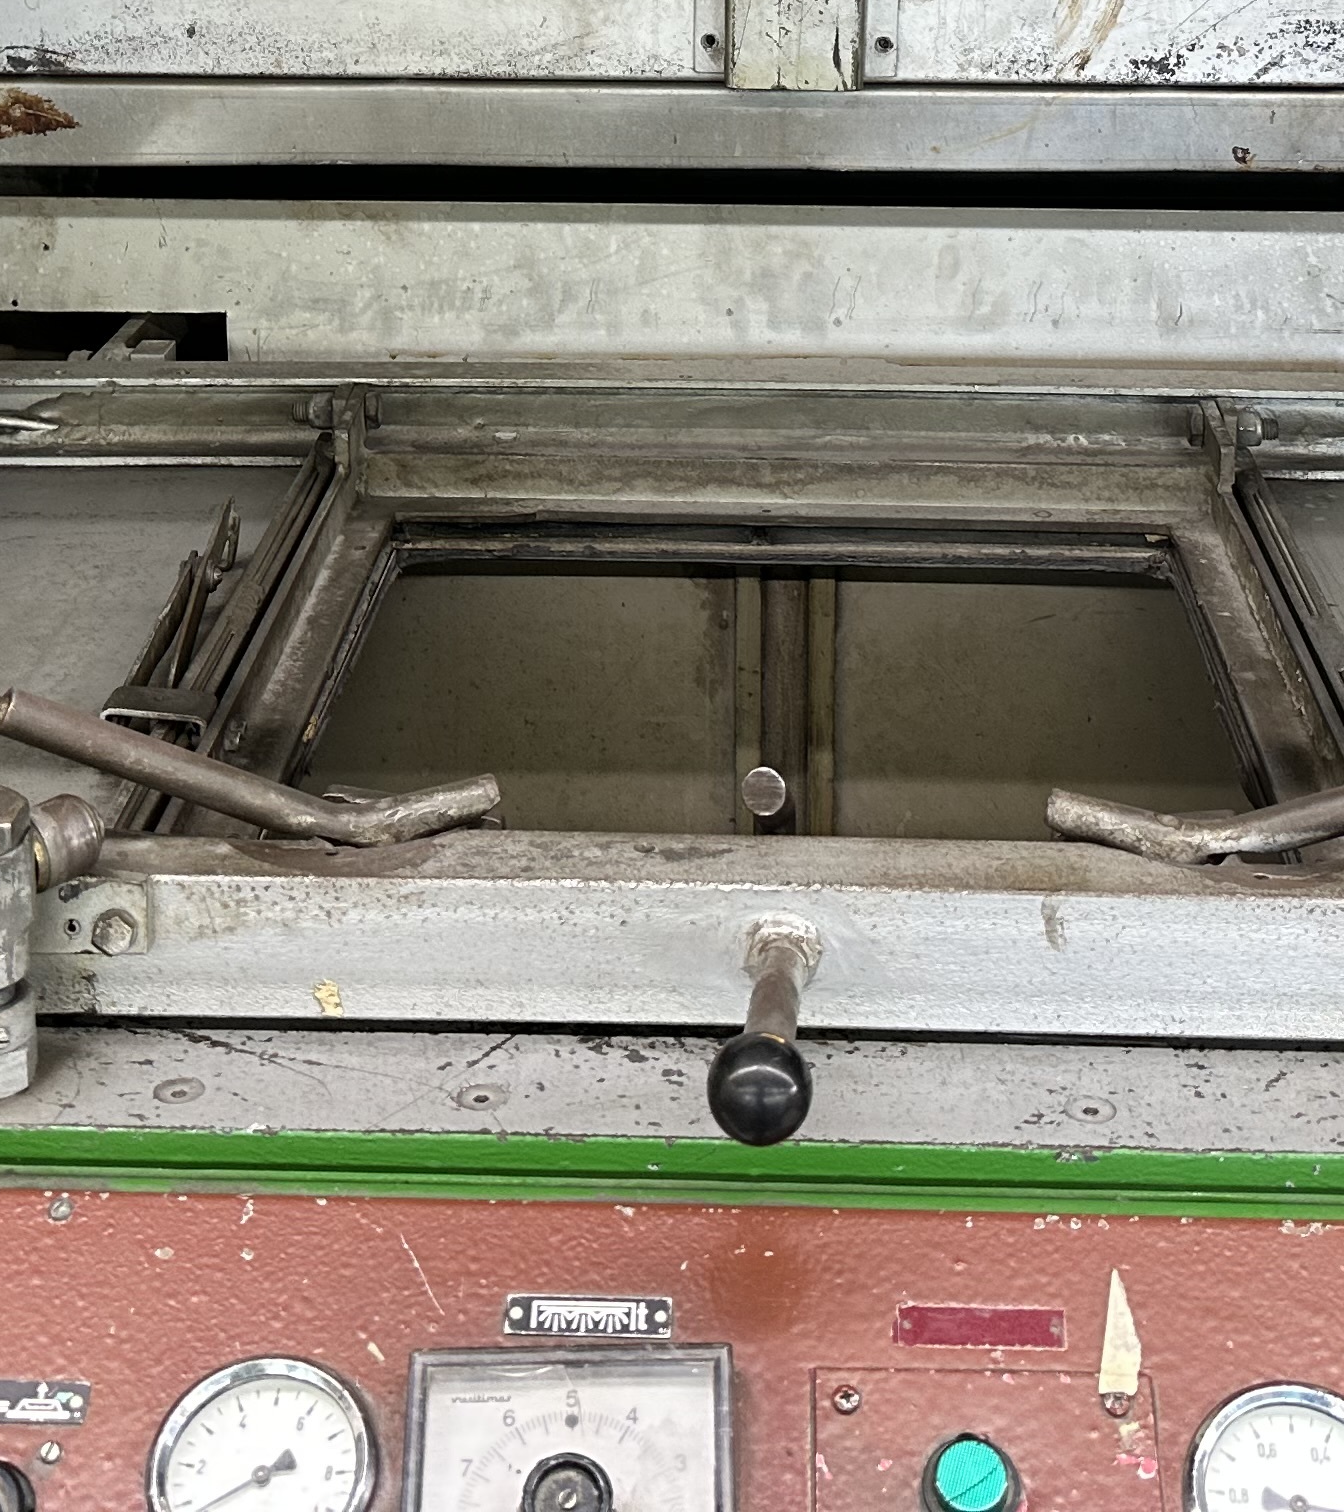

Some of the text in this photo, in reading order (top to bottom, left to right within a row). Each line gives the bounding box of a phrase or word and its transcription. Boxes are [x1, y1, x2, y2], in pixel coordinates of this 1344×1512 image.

[566, 1390, 578, 1407] 5
[296, 1415, 305, 1431] 6
[503, 1410, 515, 1427] 6
[626, 1407, 639, 1424] 4
[196, 1459, 207, 1475] 2
[461, 1459, 474, 1477] 7
[674, 1454, 687, 1471] 3
[324, 1465, 333, 1481] 8
